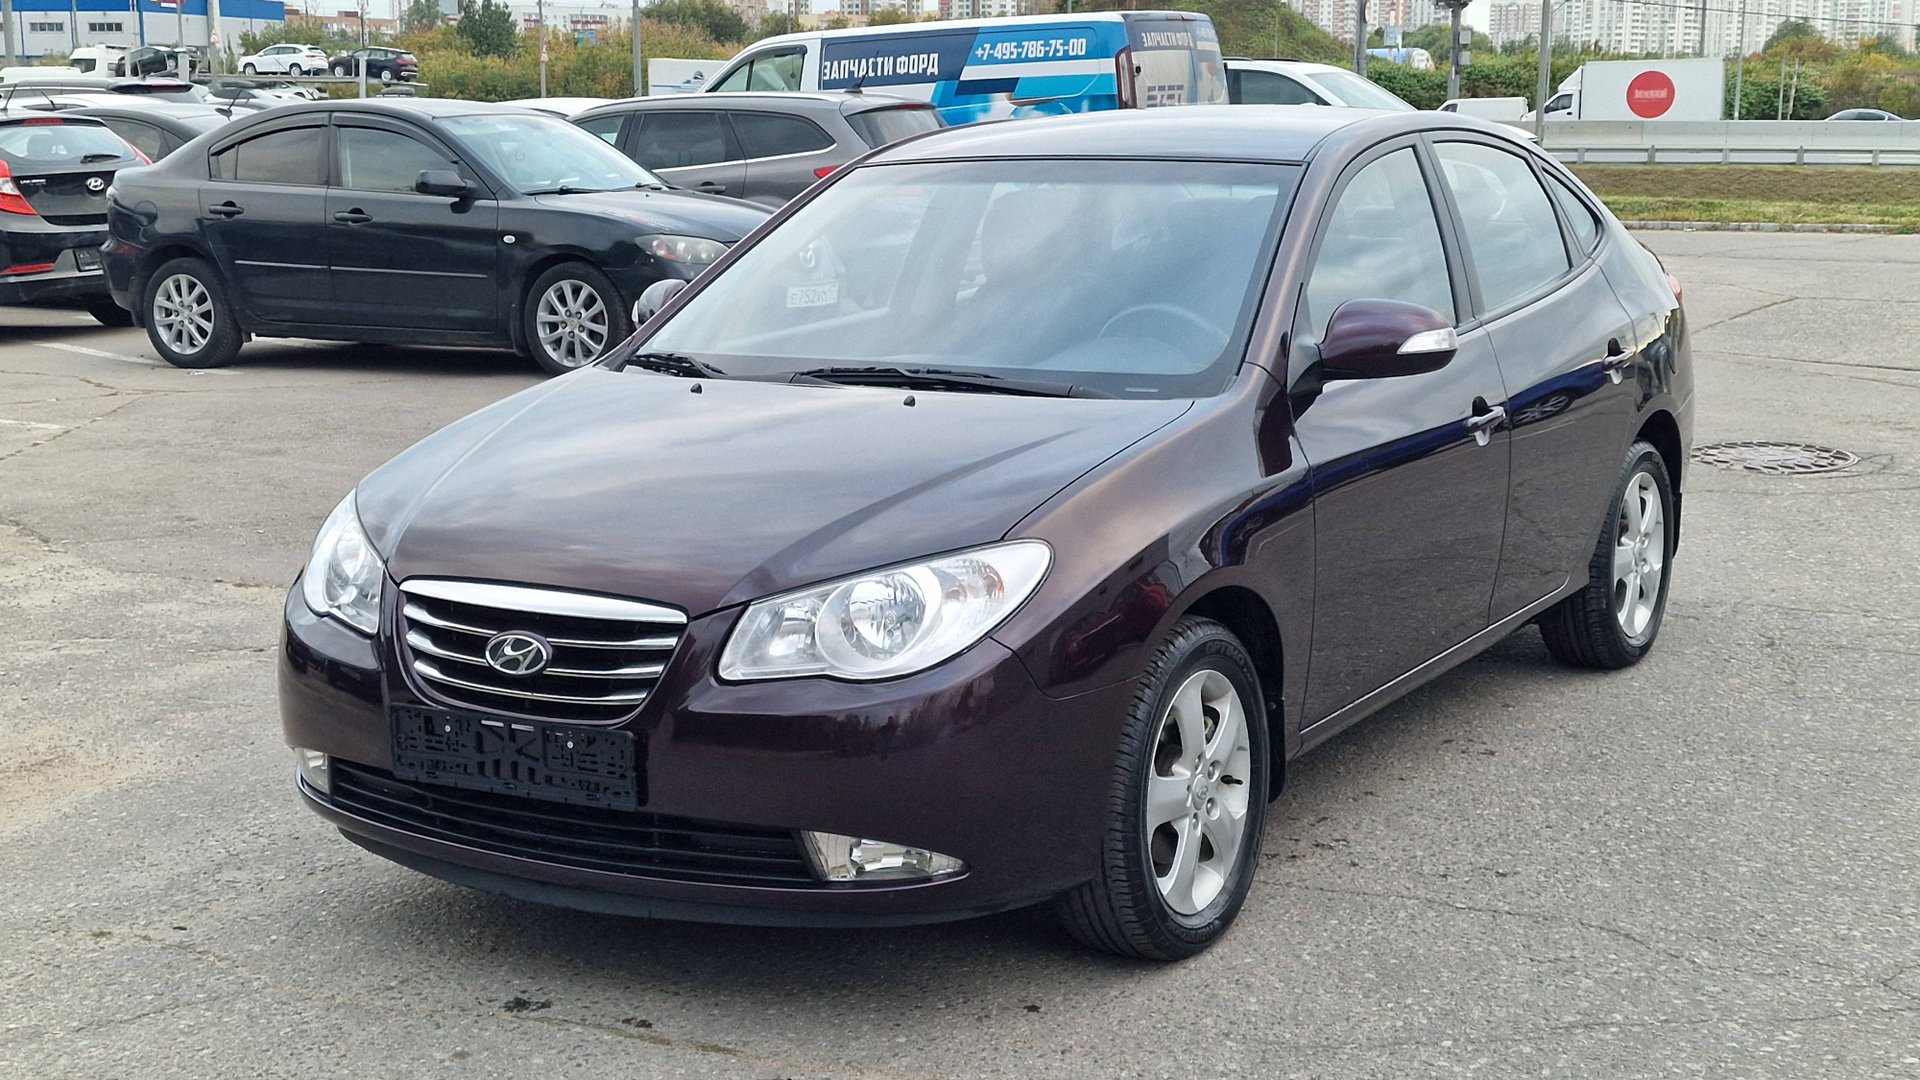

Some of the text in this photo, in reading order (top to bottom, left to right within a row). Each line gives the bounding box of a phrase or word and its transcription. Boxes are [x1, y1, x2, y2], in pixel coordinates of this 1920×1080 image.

[975, 37, 1087, 61] +7-495-786-75-00
[823, 52, 939, 81] ЗАПЧАСТИ ФОРД
